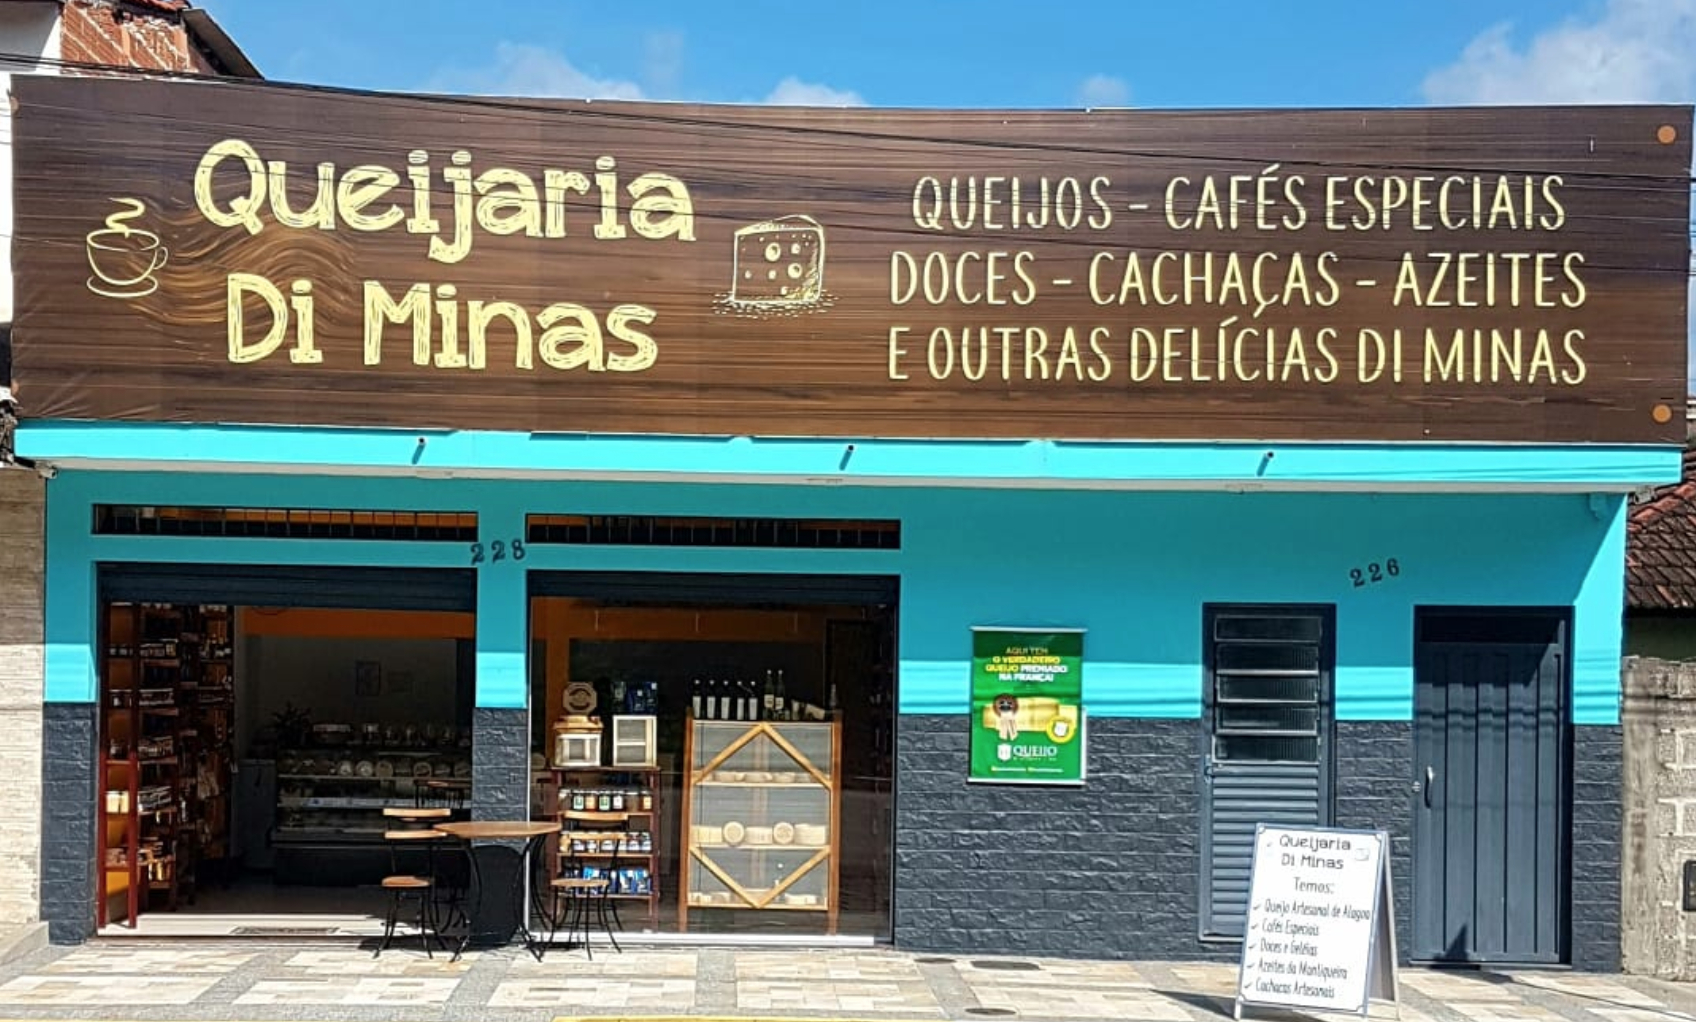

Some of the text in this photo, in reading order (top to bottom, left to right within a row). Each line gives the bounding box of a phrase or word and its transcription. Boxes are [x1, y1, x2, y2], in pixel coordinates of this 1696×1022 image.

[194, 138, 697, 263] Queijaria
[911, 175, 1113, 231] QUEIJOS
[1165, 163, 1307, 231] CAFÉS
[1324, 175, 1566, 231] ESPECIAIS
[889, 251, 1037, 306] DOCES
[1088, 251, 1341, 318] CACHAÇAS
[1393, 251, 1587, 308] AZEITES
[227, 273, 659, 372] Di Minas
[888, 316, 1587, 385] E OUTRAS DELÍCIAS DI MINAS
[471, 539, 525, 565] 228
[1350, 558, 1399, 588] 226
[986, 664, 1068, 673] QUEIJO PREMIADO
[1002, 656, 1060, 664] VERDADEIRO
[1013, 745, 1058, 757] QUEIJO
[1280, 834, 1351, 852] Queijaria
[1281, 853, 1344, 869] Di Minas
[1293, 876, 1335, 894] Temos:
[1264, 898, 1371, 922] Queijo Artesanal de Alagoa
[1262, 917, 1319, 937] Cafés Especiais
[1261, 937, 1282, 953] Doces
[1283, 943, 1288, 953] e
[1258, 956, 1348, 982] Azeites da Mantiqueira
[1293, 979, 1335, 998] Artesanais
